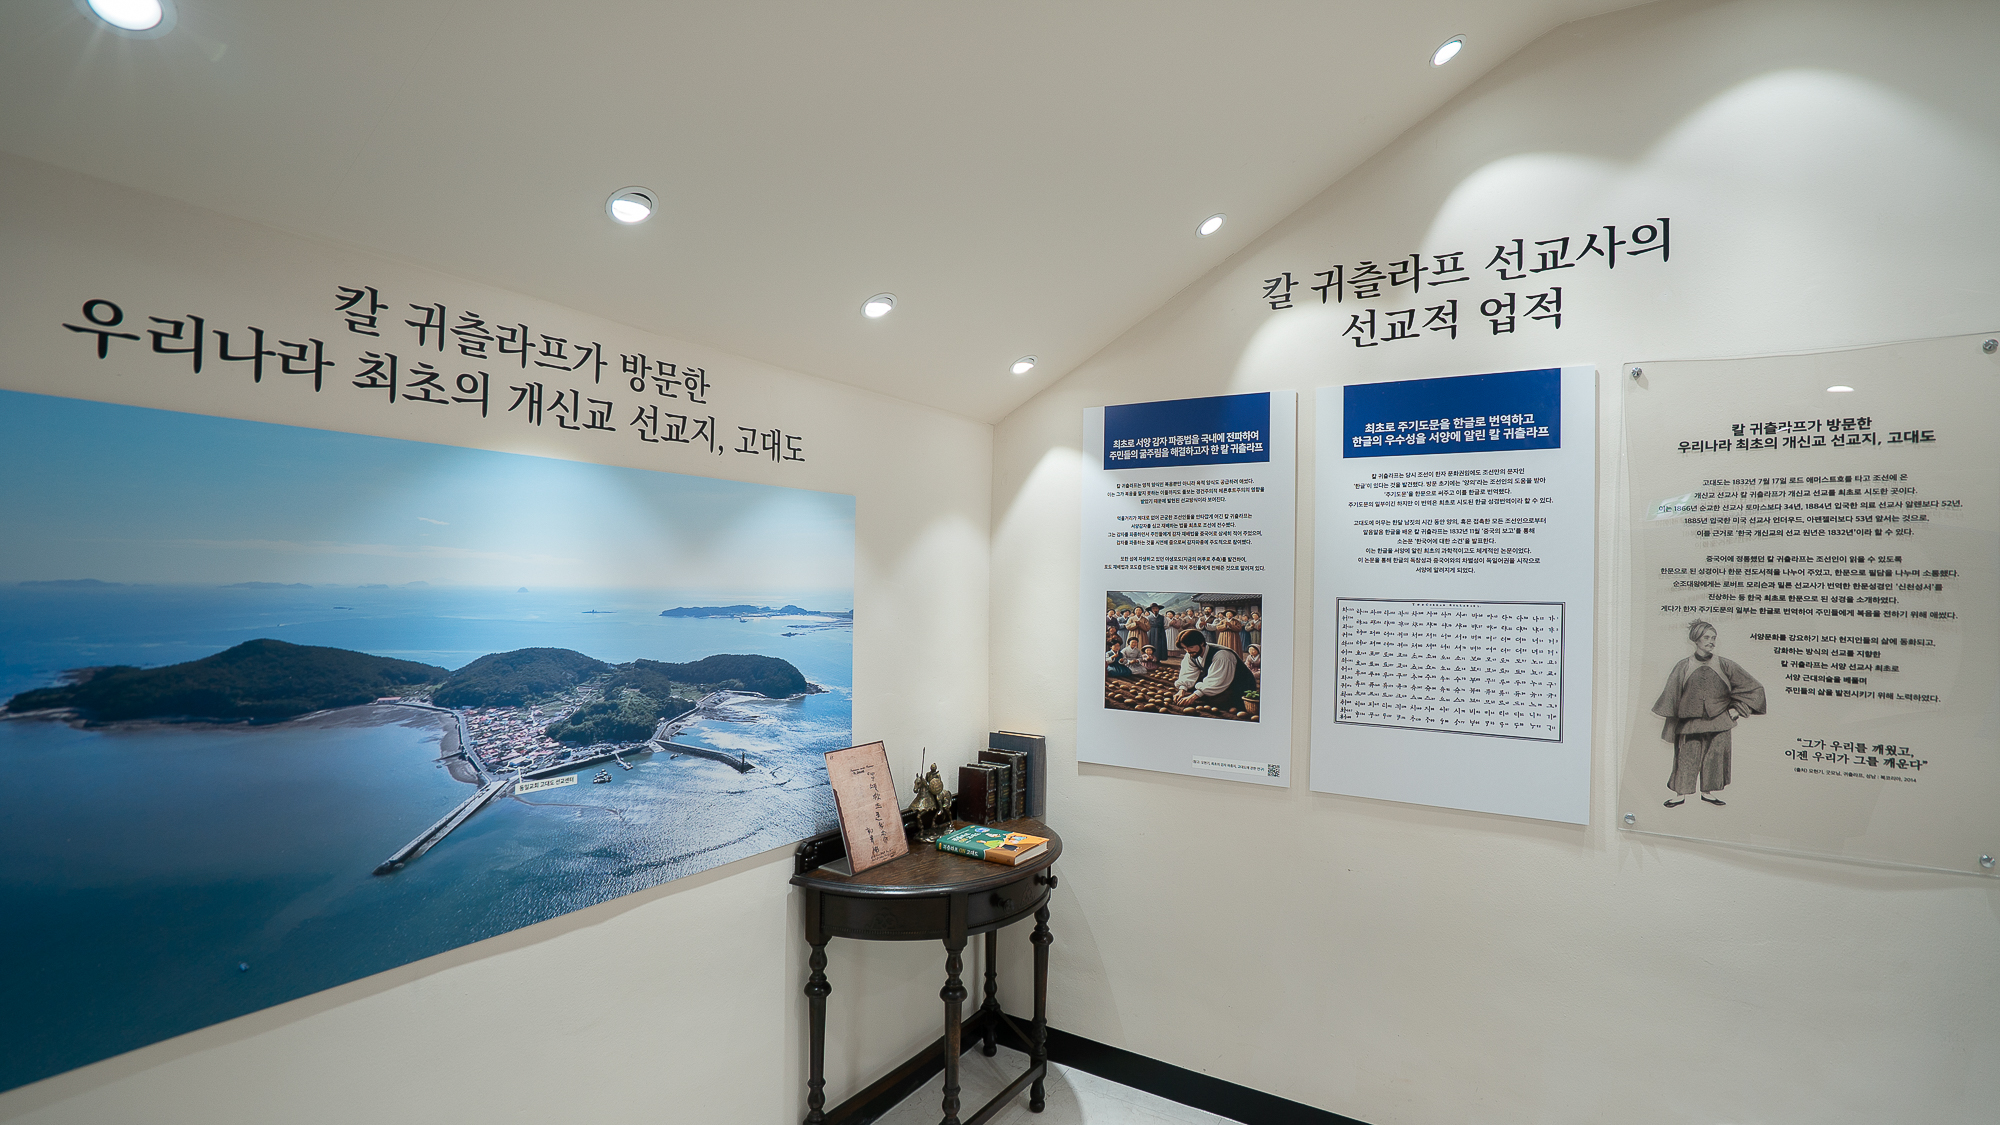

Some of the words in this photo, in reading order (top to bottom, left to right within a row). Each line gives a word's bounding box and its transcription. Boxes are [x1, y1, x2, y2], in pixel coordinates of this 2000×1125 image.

[1262, 272, 1299, 311] 칼
[1310, 251, 1470, 305] 귀츨라프
[1485, 217, 1670, 281] 선교사의
[1341, 299, 1458, 348] 선교적
[1480, 286, 1562, 336] 업적
[334, 285, 389, 338] 칼
[404, 302, 608, 385] 귀츨라프가
[620, 353, 711, 405] 방문한
[61, 298, 336, 393] 우리나라
[351, 350, 489, 419] 최초의
[507, 381, 616, 432] 개신교
[629, 404, 724, 456] 선교지,
[734, 425, 806, 464] 고대도
[1364, 422, 1396, 433] 최초로
[1397, 418, 1451, 432] 주기도문을
[1452, 416, 1486, 429] 한글로
[1488, 413, 1535, 427] 번역하고
[1731, 423, 1746, 436] 칼
[1749, 419, 1822, 435] 귀츨라프가
[1826, 416, 1872, 432] 방문한
[1112, 439, 1135, 448] 최초로
[1135, 437, 1151, 447] 서양
[1152, 436, 1168, 446] 감자
[1168, 434, 1200, 446] 파종법을
[1200, 432, 1225, 444] 국내에
[1226, 430, 1259, 442] 전파하여
[1352, 435, 1382, 447] 한글의
[1384, 432, 1427, 445] 우수성을
[1428, 430, 1461, 443] 서양에
[1463, 429, 1486, 441] 알린
[1488, 428, 1501, 440] 칼
[1503, 426, 1550, 439] 귀츨라프
[1677, 439, 1732, 453] 우리나라
[1735, 435, 1777, 450] 최초의
[1782, 435, 1827, 448] 개신교
[1830, 432, 1882, 447] 선교지,
[1887, 430, 1936, 443] 고대도
[1109, 448, 1138, 460] 주민들의
[1139, 447, 1169, 459] 굶주림을
[1170, 445, 1210, 456] 해결하고자
[1210, 444, 1219, 455] 한
[1220, 444, 1229, 454] 칼
[1229, 442, 1263, 453] 귀츨라프
[1732, 478, 1756, 486] 1832년
[1758, 477, 1770, 485] 7월
[1772, 477, 1787, 485] 17일
[1788, 476, 1804, 484] 로드
[1805, 475, 1852, 483] 애머스트호를
[1854, 474, 1871, 482] 타고
[1872, 473, 1897, 481] 조선에
[1899, 473, 1908, 481] 온
[1749, 490, 1786, 498] 귀츨라프가
[1787, 489, 1811, 497] 개신교
[1812, 489, 1836, 497] 선교를
[1837, 488, 1862, 496] 최초로
[1863, 487, 1888, 495] 시도한
[1890, 487, 1918, 495] 곳이다.
[1732, 516, 1747, 526] 미국
[1748, 516, 1771, 524] 선교사
[1772, 516, 1805, 524] 언더우드,
[1875, 514, 1900, 522] 앞서는
[1902, 514, 1930, 522] 것으로,
[1696, 529, 1711, 537] 이를
[1712, 529, 1734, 537] 근거로
[1753, 529, 1784, 537] 개신교의
[1802, 528, 1826, 536] 원년은
[1874, 528, 1883, 536] 할
[1884, 528, 1893, 536] 수
[1895, 528, 1914, 536] 있다.
[1749, 633, 1787, 641] 서양문화를
[1788, 634, 1819, 642] 강요하기
[1820, 635, 1837, 643] 보다
[1838, 636, 1879, 644] 현지인들의
[1880, 637, 1897, 645] 삶에
[1899, 638, 1936, 646] 동화되고,
[1773, 646, 1804, 655] 감화하는
[1805, 648, 1829, 656] 방식의
[1830, 649, 1855, 657] 선교를
[1856, 650, 1881, 658] 지향한
[1790, 660, 1829, 669] 귀츨라프는
[1830, 662, 1847, 670] 서양
[1848, 663, 1873, 671] 선교사
[1874, 664, 1899, 672] 최초로
[1785, 673, 1801, 681] 서양
[1802, 674, 1841, 683] 근대의술을
[1843, 676, 1867, 685] 베풀며
[1785, 686, 1816, 695] 주민들의
[1817, 688, 1833, 696] 삶을
[1835, 689, 1875, 698] 발전시키기
[1877, 691, 1894, 700] 위해
[1896, 693, 1941, 702] 노력하였다.
[1784, 749, 1808, 761] 이젠
[1812, 751, 1850, 764] 우리가
[1853, 755, 1879, 767] 그를
[1829, 740, 1868, 753] 우리를
[1871, 744, 1914, 758] 깨웠고,
